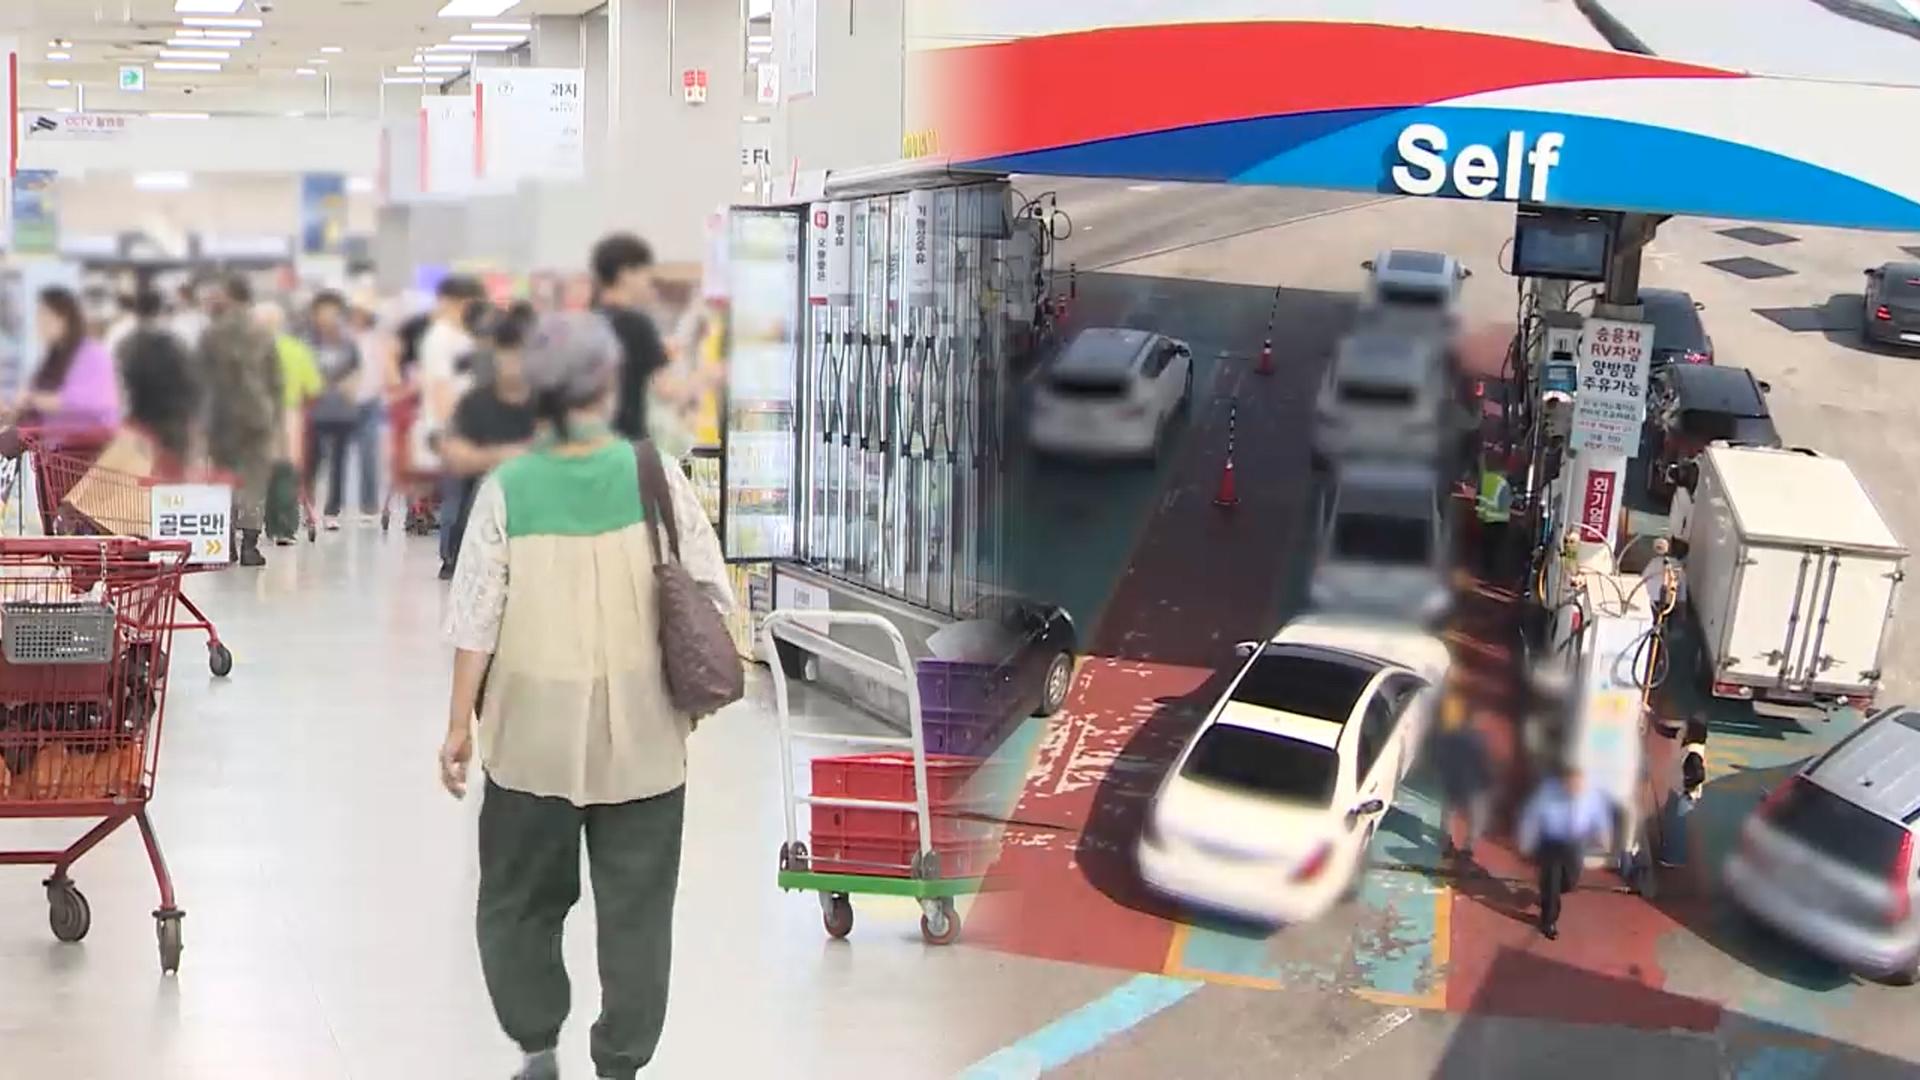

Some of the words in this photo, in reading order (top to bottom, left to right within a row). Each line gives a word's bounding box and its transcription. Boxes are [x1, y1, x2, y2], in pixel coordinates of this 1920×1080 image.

[550, 83, 577, 98] 과자
[65, 116, 94, 126] CCTV
[1393, 123, 1564, 201] Self
[1596, 327, 1640, 344] 승용차
[1591, 343, 1641, 362] RV차량
[1593, 360, 1636, 379] 양방향
[1583, 376, 1641, 396] 주유가능
[160, 514, 224, 536] 골드만!
